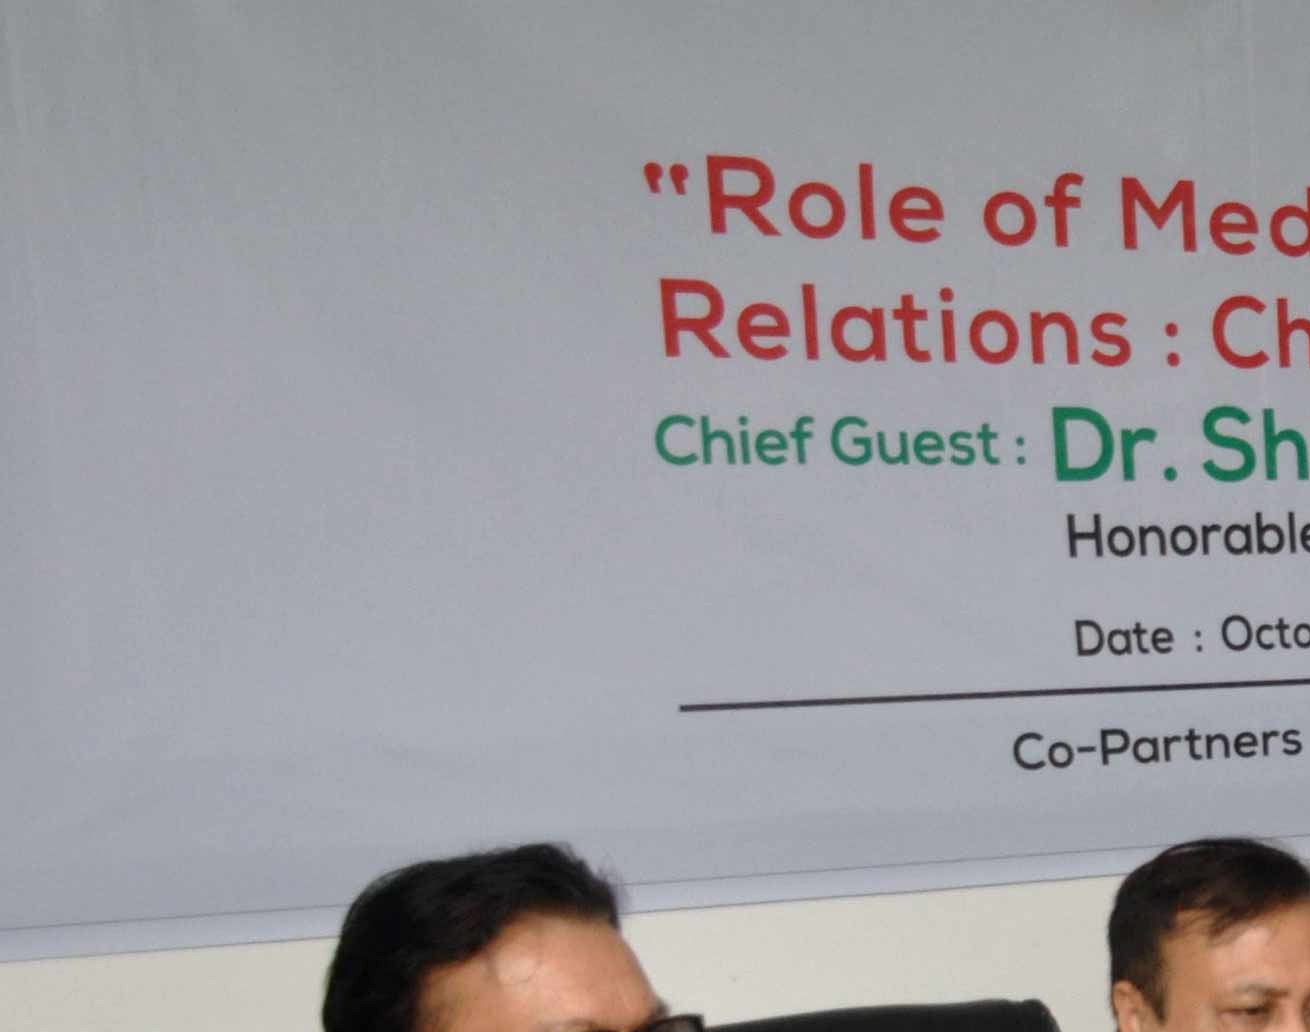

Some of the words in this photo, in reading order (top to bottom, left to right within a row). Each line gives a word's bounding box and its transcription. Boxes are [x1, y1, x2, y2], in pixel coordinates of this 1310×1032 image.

[983, 172, 1084, 247] of
[659, 278, 1131, 367] Relations
[655, 415, 814, 466] Chief
[831, 416, 1000, 466] Guest
[1052, 407, 1178, 481] Dr.
[1075, 620, 1175, 656] Date
[1012, 728, 1303, 770] Co-Partners
